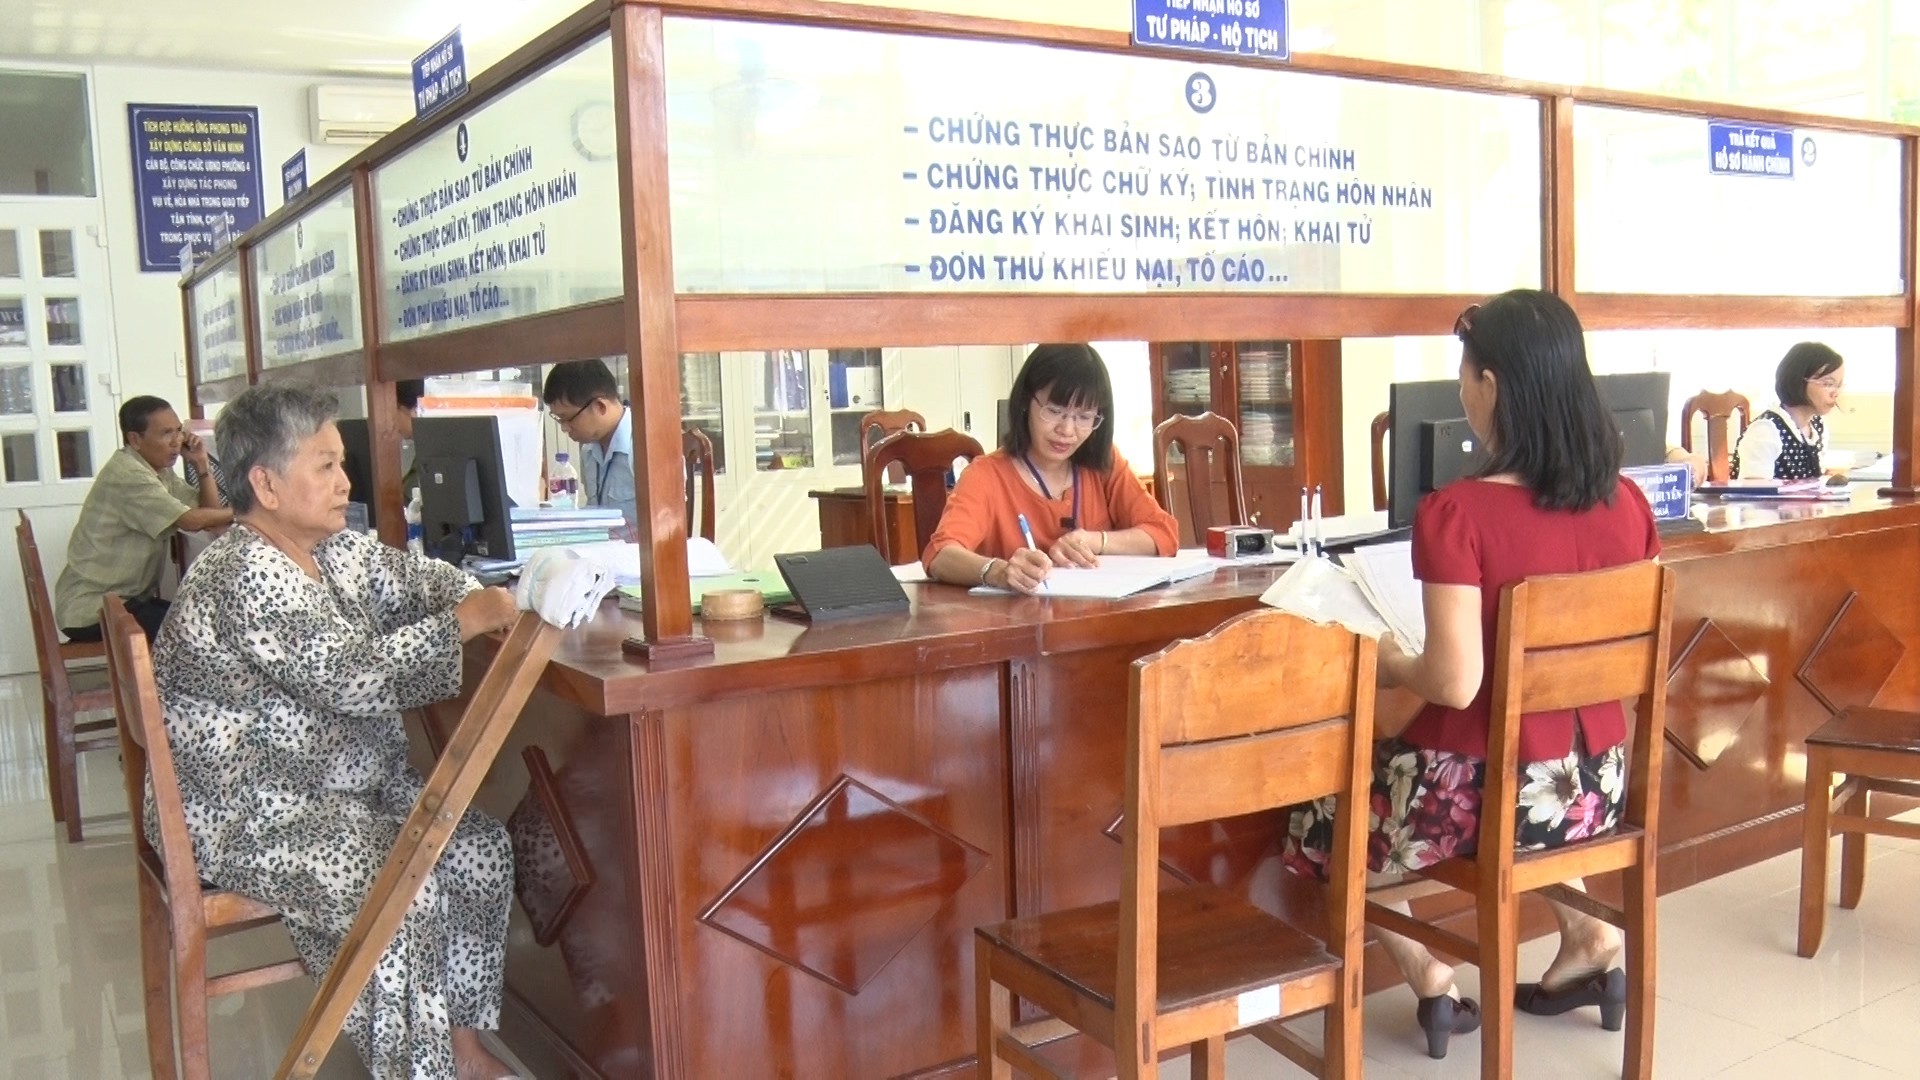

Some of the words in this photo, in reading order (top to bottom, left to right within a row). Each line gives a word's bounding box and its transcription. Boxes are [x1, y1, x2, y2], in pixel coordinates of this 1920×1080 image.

[1146, 14, 1168, 40] TƯ
[1170, 16, 1210, 43] PHÁP
[1221, 21, 1242, 54] HỘ
[1244, 27, 1278, 56] TỊCH
[1190, 76, 1213, 110] 3
[928, 112, 1020, 146] CHỨNG
[1029, 122, 1094, 158] THỰC
[1104, 120, 1150, 154] BẢN
[1158, 133, 1201, 160] SAO
[1212, 132, 1240, 162] TỪ
[1246, 133, 1287, 166] BẢN
[1294, 141, 1355, 171] CHÍNH
[214, 179, 238, 190] PHONG
[439, 180, 454, 210] BẢN
[455, 176, 470, 202] SAO
[484, 154, 502, 188] BẢN
[504, 144, 532, 180] CHÍNH
[927, 158, 1019, 190] CHỨNG
[1029, 163, 1093, 200] THỰC
[1102, 165, 1152, 196] CHỮ
[1160, 167, 1196, 202] KÝ;
[1206, 170, 1254, 200] TÌNH
[1262, 178, 1330, 210] TRẠNG
[1336, 178, 1376, 206] HÔN
[1382, 182, 1432, 208] NHÂN
[472, 206, 490, 234] TÌNH
[493, 192, 522, 228] TRẠNG
[524, 182, 544, 214] HÔN
[548, 168, 576, 205] NHÂN
[930, 202, 1004, 234] ĐĂNG
[1012, 204, 1046, 236] KÝ
[1055, 212, 1112, 236] KHAI
[1120, 213, 1181, 243] SINH;
[1188, 208, 1230, 240] KẾT
[1238, 213, 1287, 246] HÔN;
[1294, 220, 1340, 244] KHAI
[1347, 213, 1373, 244] TỬ
[430, 263, 446, 288] KHAI
[469, 242, 484, 276] KẾT
[508, 233, 530, 264] KHAI
[532, 222, 546, 255] TỬ
[930, 250, 986, 282] ĐƠN
[994, 252, 1046, 281] THƯ
[1053, 248, 1126, 280] KHIẾU
[1186, 250, 1216, 282] TỐ
[470, 282, 480, 314] TỐ
